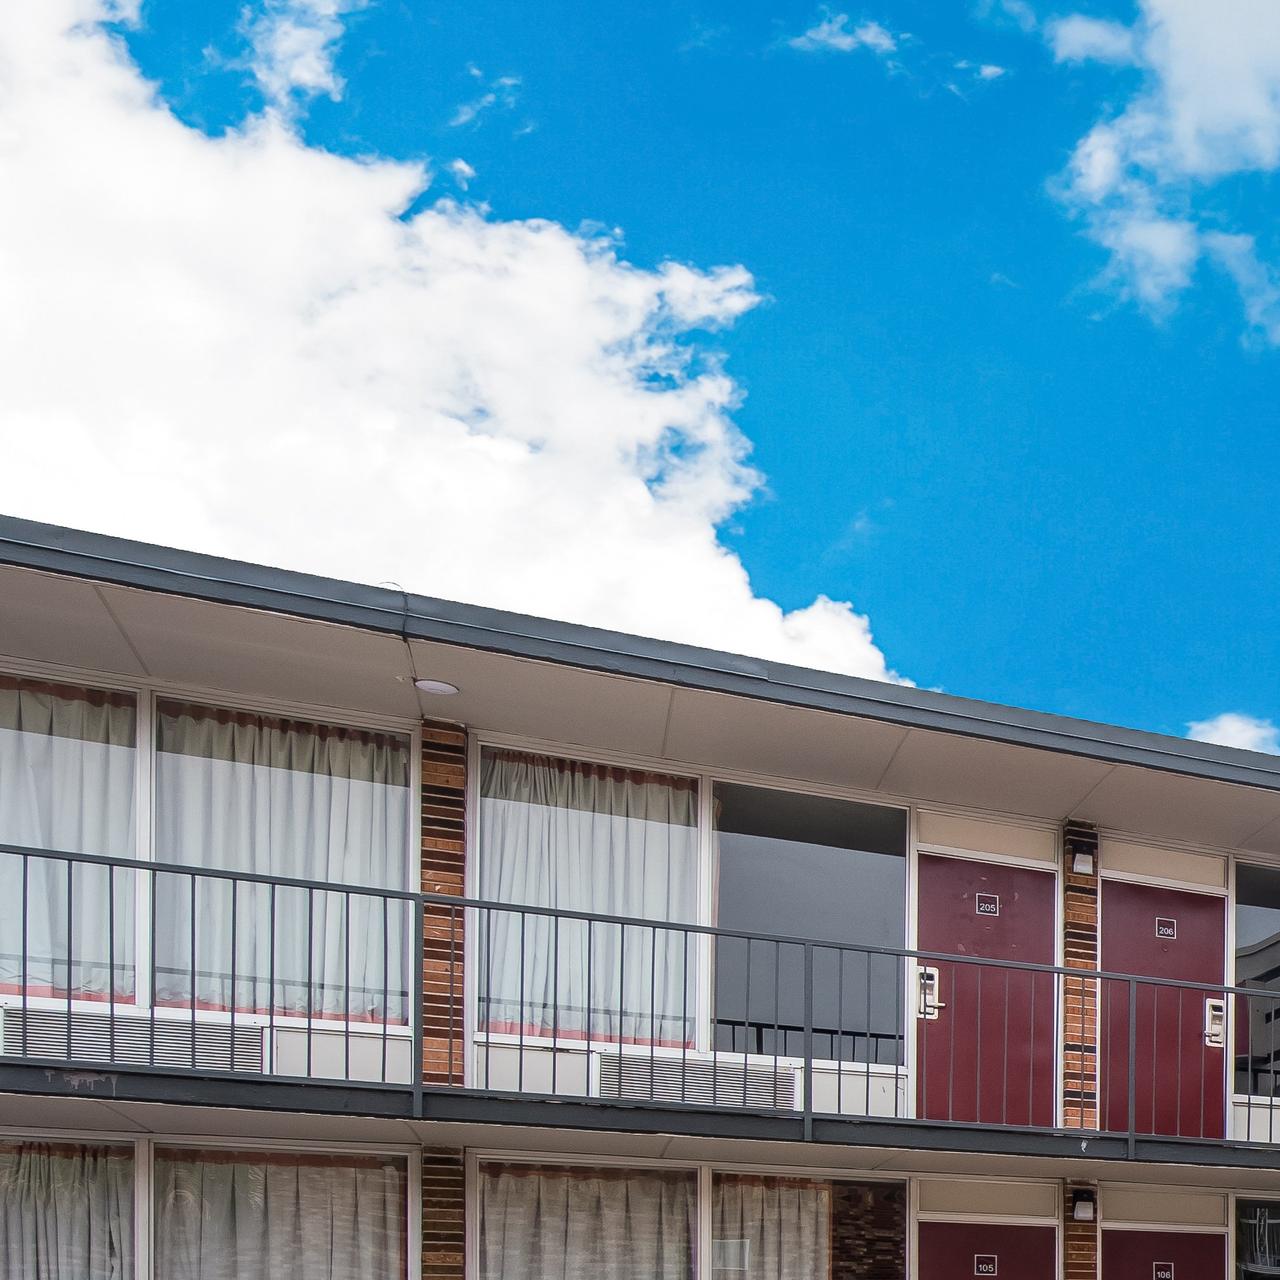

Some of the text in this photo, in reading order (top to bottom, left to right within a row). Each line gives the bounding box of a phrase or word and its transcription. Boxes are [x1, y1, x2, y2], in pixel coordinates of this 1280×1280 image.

[979, 903, 996, 912] 205
[1159, 927, 1174, 936] 206
[978, 1264, 994, 1272] 105
[1156, 1271, 1171, 1279] 106
